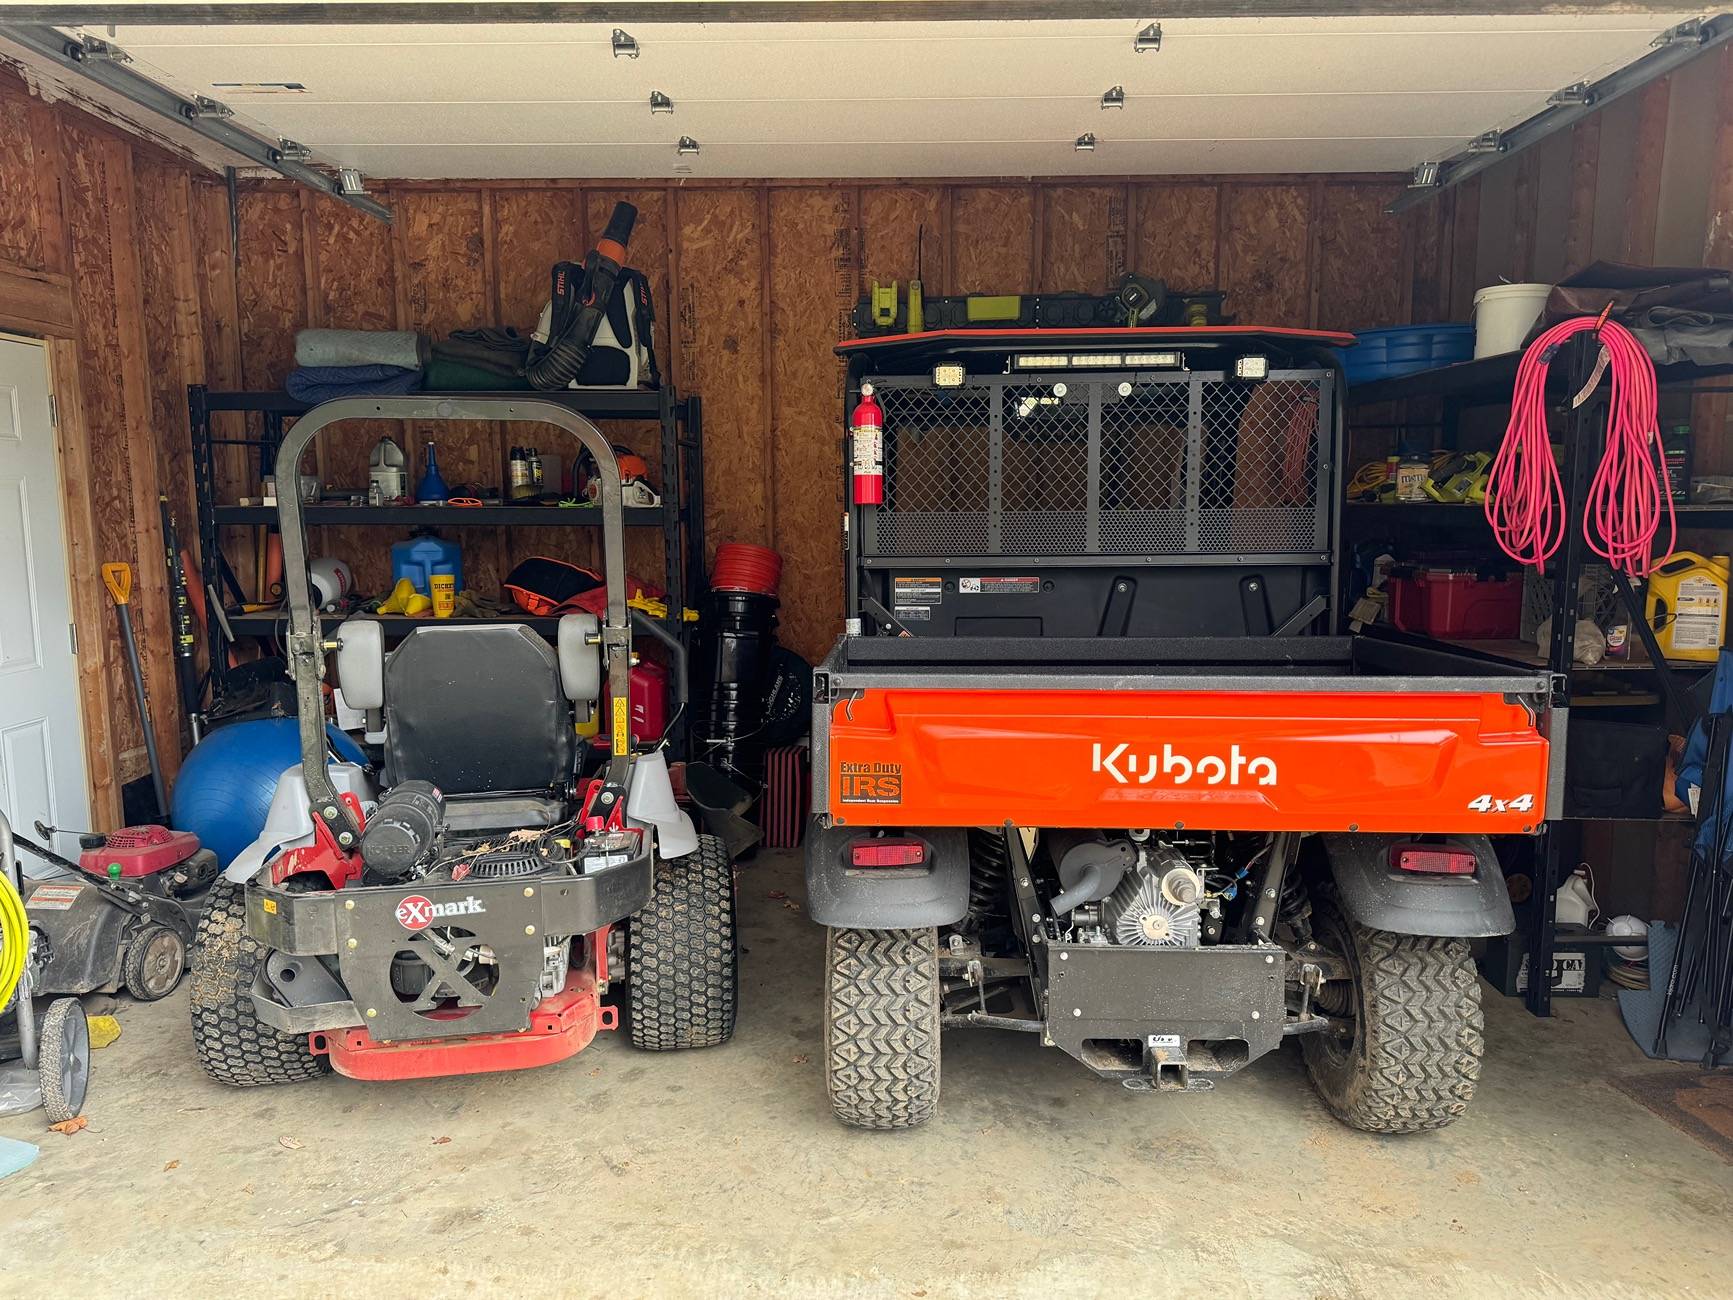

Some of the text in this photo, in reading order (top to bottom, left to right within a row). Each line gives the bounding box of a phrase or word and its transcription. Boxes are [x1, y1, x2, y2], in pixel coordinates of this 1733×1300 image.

[556, 271, 566, 297] STIHL
[840, 762, 902, 775] Extra Duty
[1092, 743, 1278, 786] Kubota
[842, 776, 900, 797] IRS
[1467, 793, 1535, 814] 4x4
[396, 895, 486, 924] eXmark
